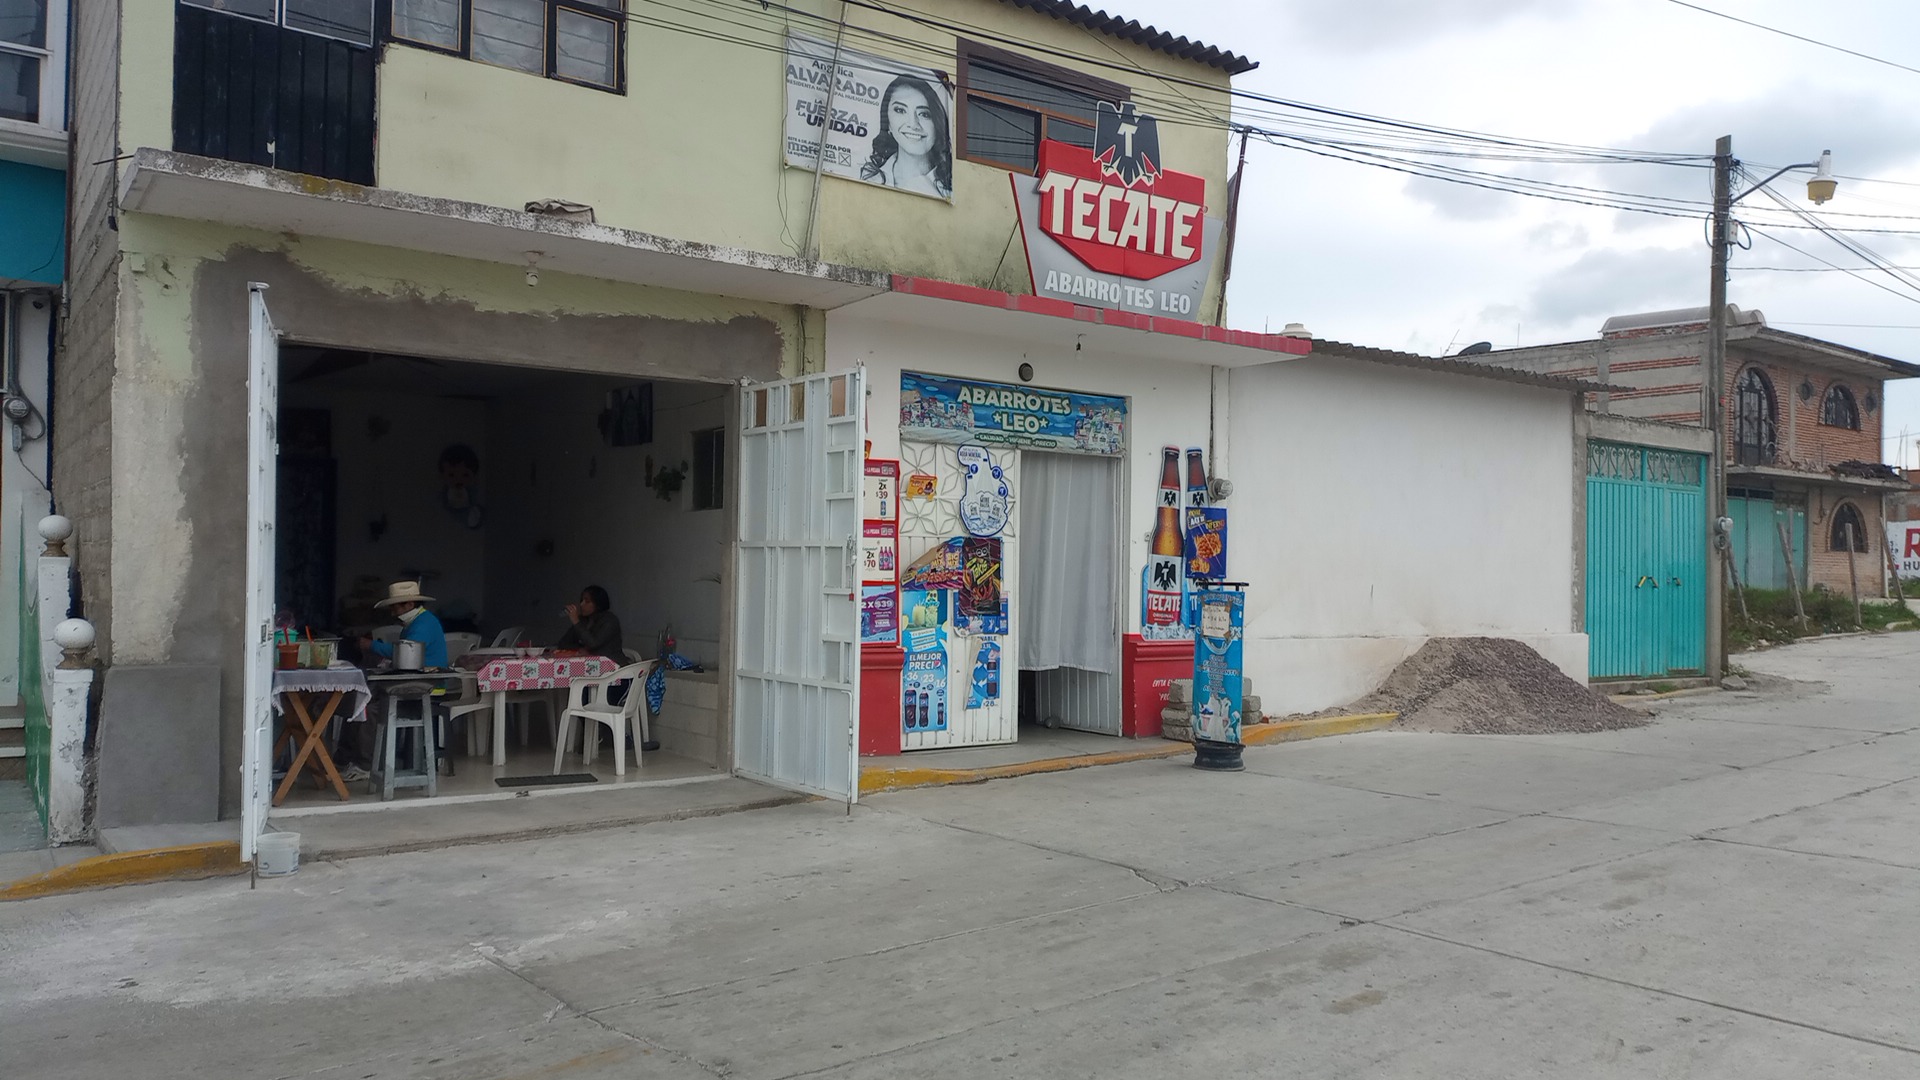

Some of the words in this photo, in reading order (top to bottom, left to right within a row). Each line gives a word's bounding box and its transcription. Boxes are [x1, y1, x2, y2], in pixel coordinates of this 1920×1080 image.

[812, 60, 854, 78] Anglica
[787, 64, 880, 100] ALVARADO
[796, 99, 860, 125] FUERZA
[806, 114, 868, 138] UNIDAD
[1038, 170, 1201, 260] TECATE
[1160, 291, 1191, 315] LEO
[957, 385, 1072, 415] ABARROTES
[1148, 594, 1181, 611] TECATE
[916, 653, 942, 662] MEJOR
